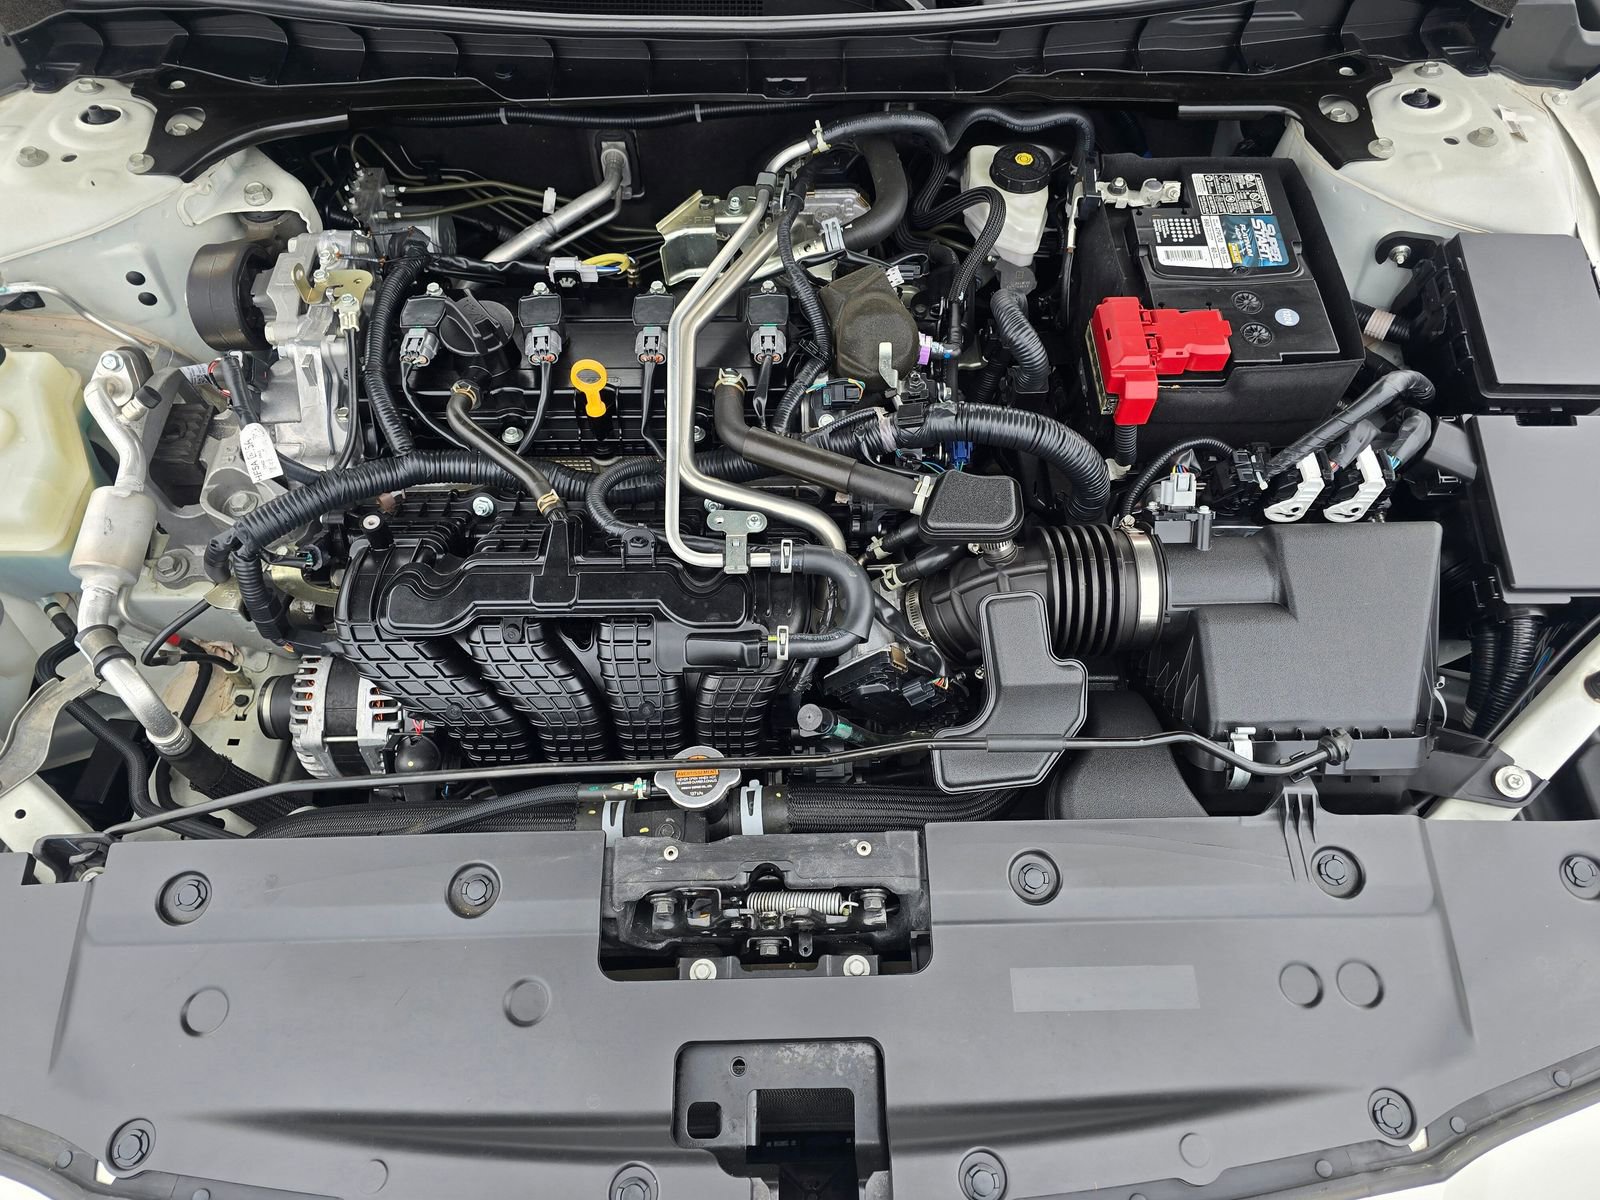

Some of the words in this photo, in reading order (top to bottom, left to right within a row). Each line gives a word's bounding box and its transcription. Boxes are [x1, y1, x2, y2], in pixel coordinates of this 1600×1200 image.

[1240, 224, 1254, 256] PLATINUM
[1251, 218, 1271, 260] START
[1267, 224, 1283, 262] SUPER
